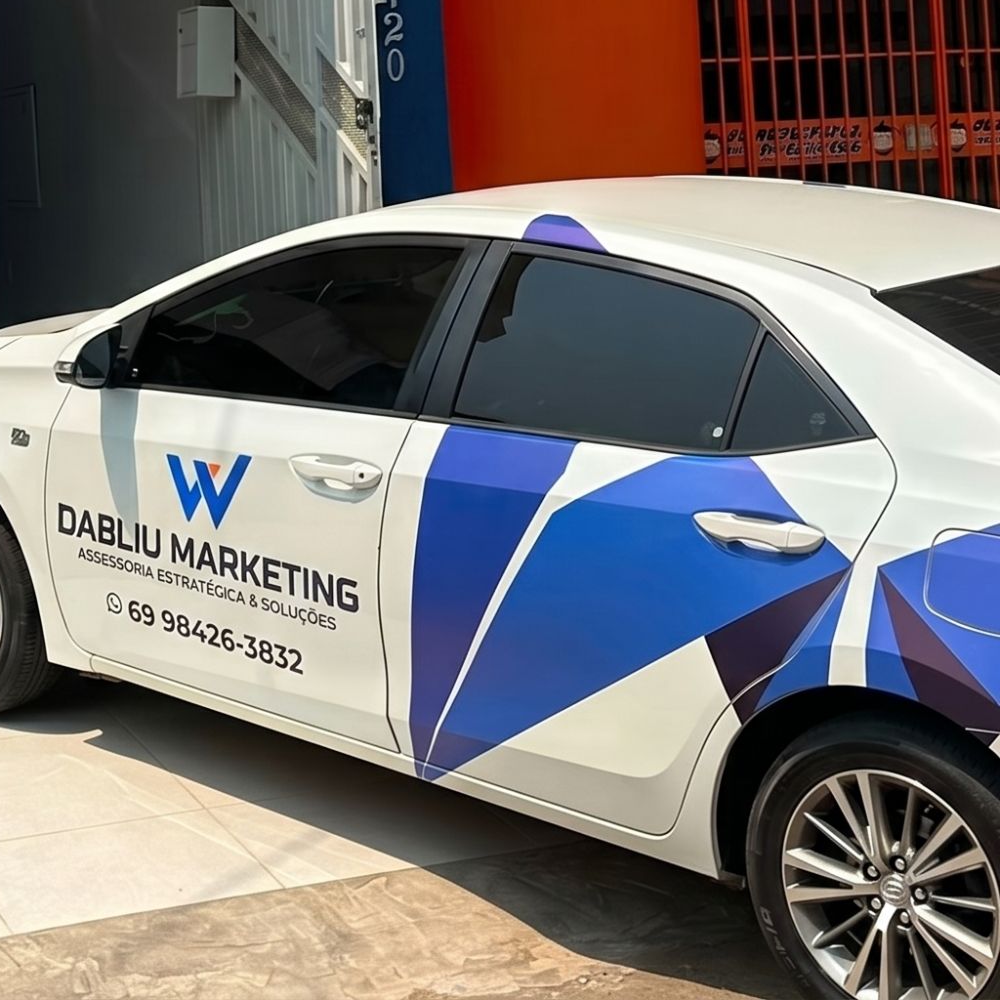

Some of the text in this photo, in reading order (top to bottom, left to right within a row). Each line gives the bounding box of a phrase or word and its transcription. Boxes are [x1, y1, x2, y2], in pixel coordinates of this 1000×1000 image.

[57, 502, 361, 614] DABLIU MARKETING
[77, 546, 338, 632] ASSESSORIA ESTRATÉGICA & SOLUÇÕES
[127, 600, 304, 676] 69 98426-3832
